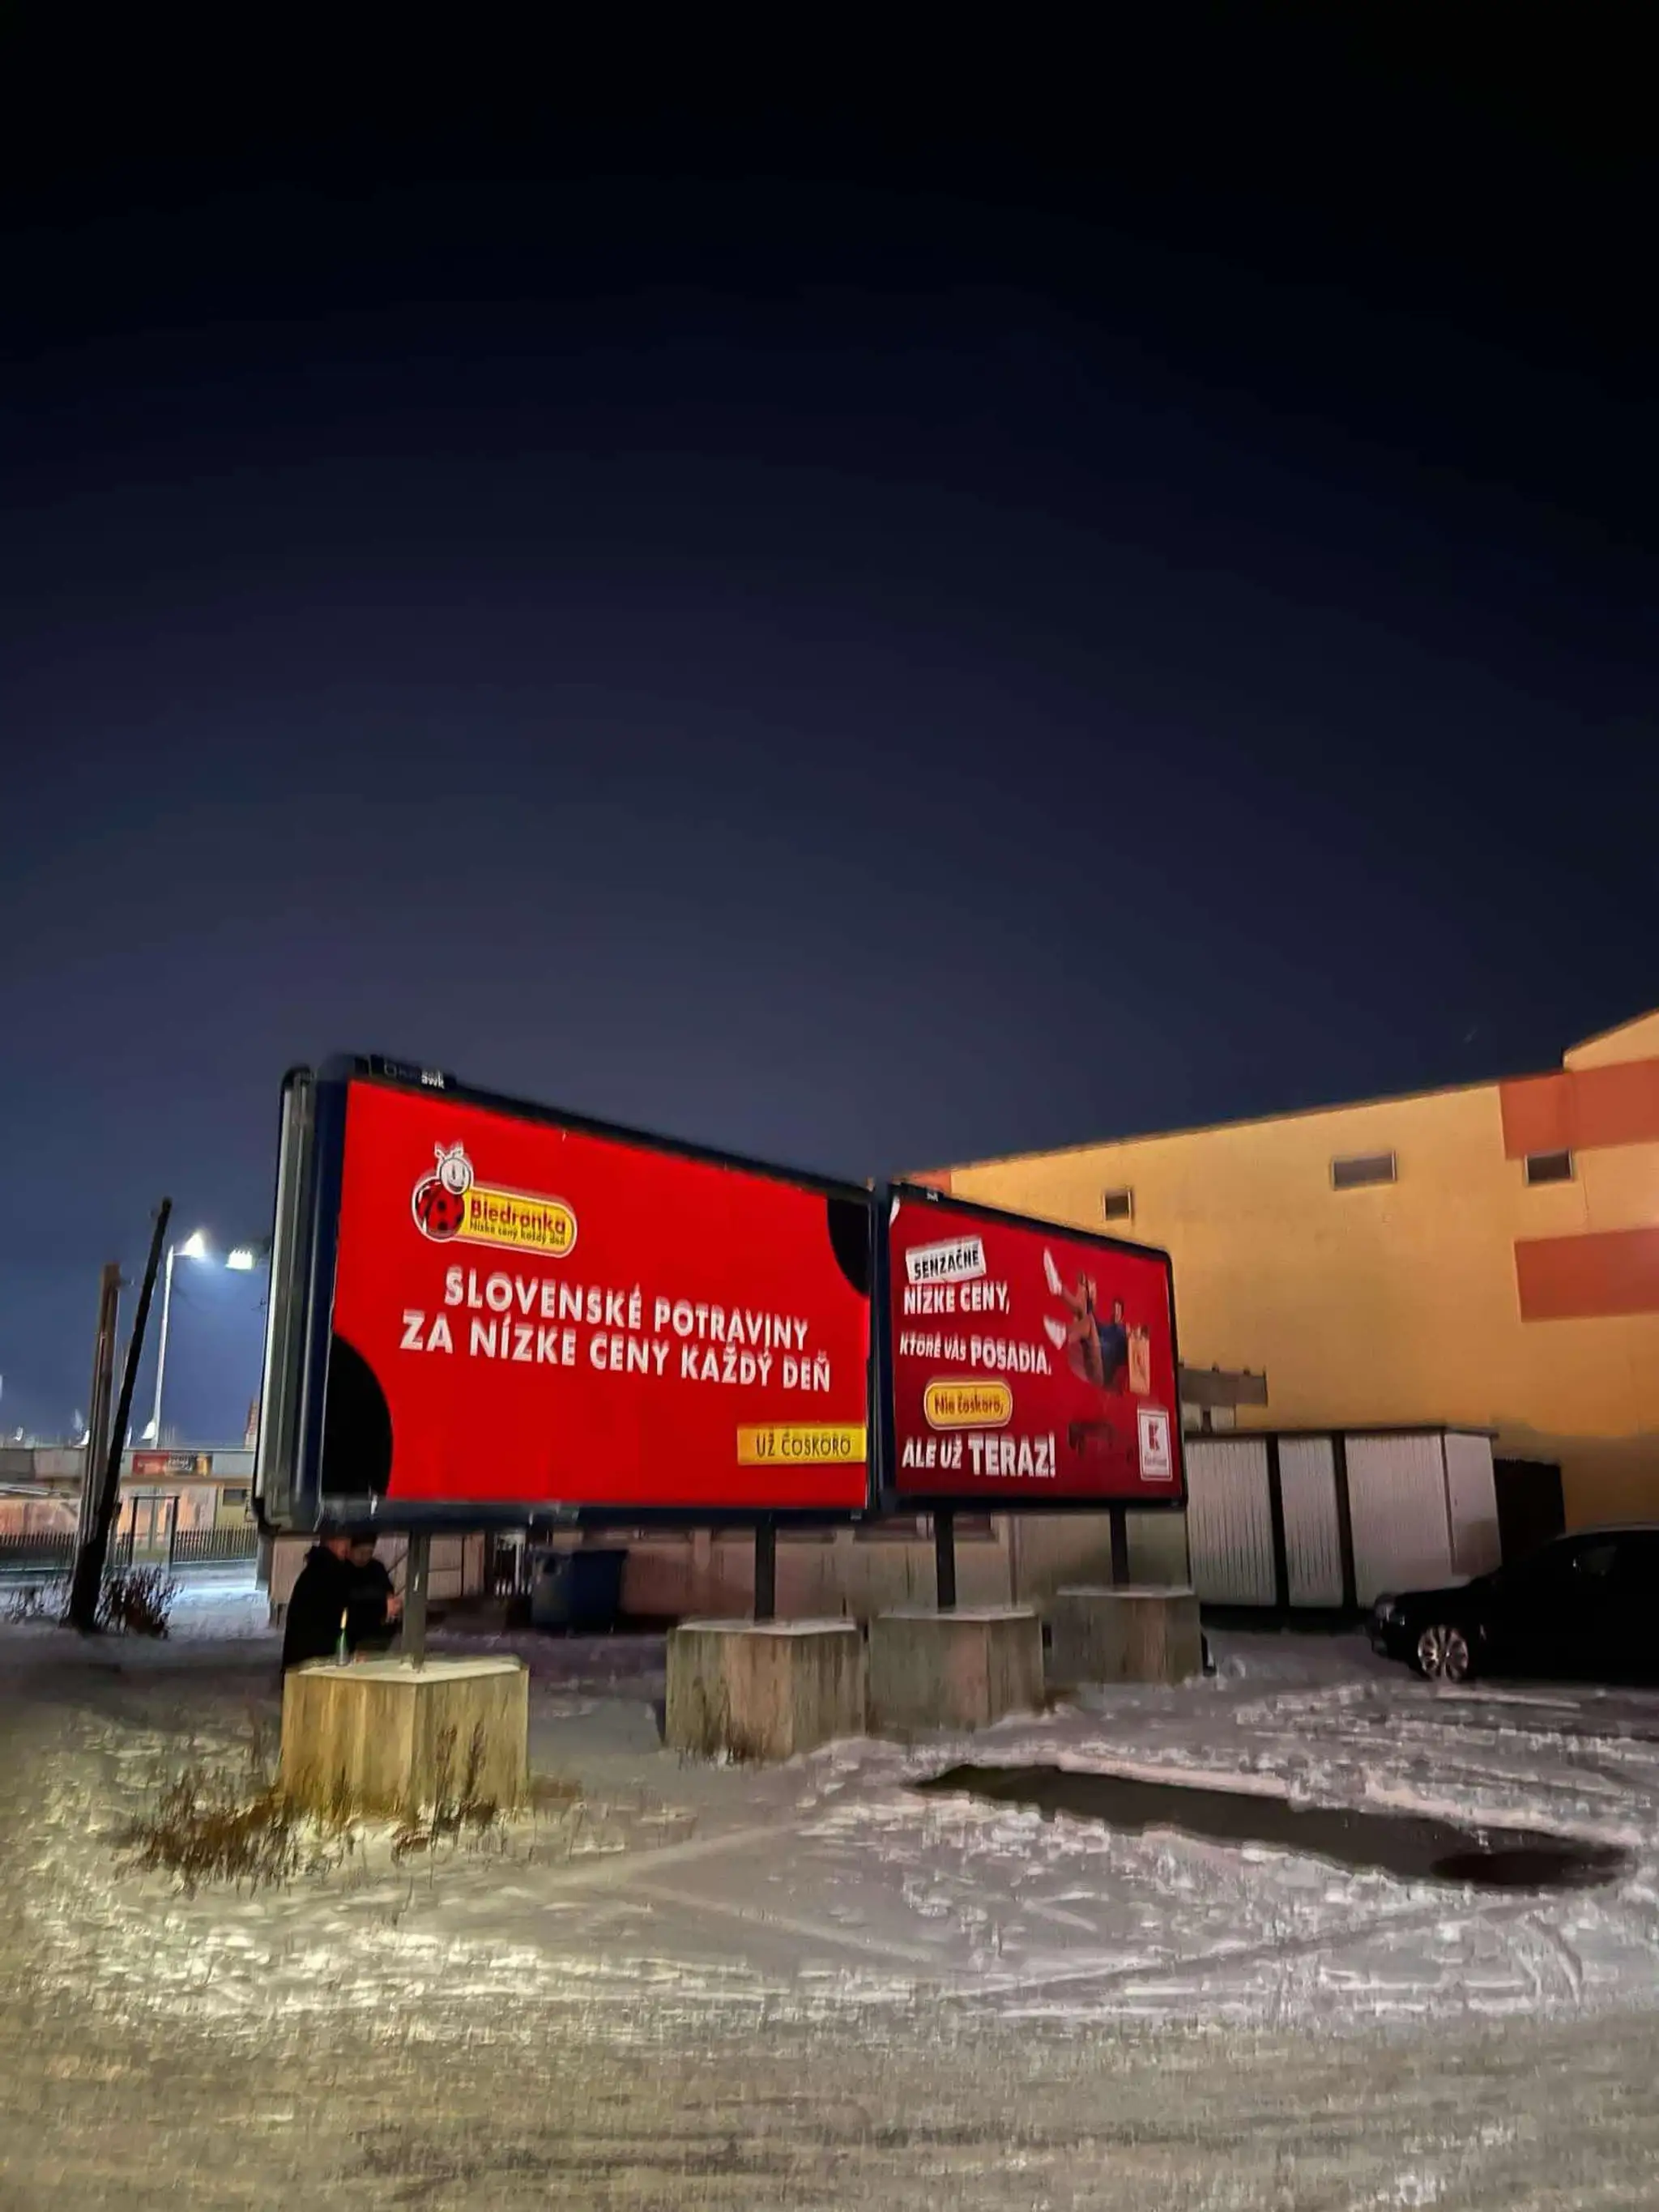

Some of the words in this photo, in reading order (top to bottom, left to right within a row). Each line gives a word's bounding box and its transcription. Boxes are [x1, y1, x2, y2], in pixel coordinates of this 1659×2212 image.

[471, 1198, 565, 1234] Biedronka
[444, 1264, 642, 1330] SLOVENSKÉ
[655, 1296, 808, 1351] POTRAVINY
[960, 1280, 1010, 1315] CENY,
[399, 1309, 454, 1353] ZA
[469, 1311, 577, 1366] NÍZKE
[590, 1331, 669, 1375] CENY
[681, 1341, 772, 1387] KAŽDÝ
[783, 1349, 830, 1392] DEŇ
[757, 1429, 775, 1457] UŽ
[782, 1428, 851, 1456] ČOSKORO
[902, 1436, 937, 1468] ALE
[940, 1434, 963, 1469] UŽ
[968, 1432, 1056, 1478] TERAZ!
